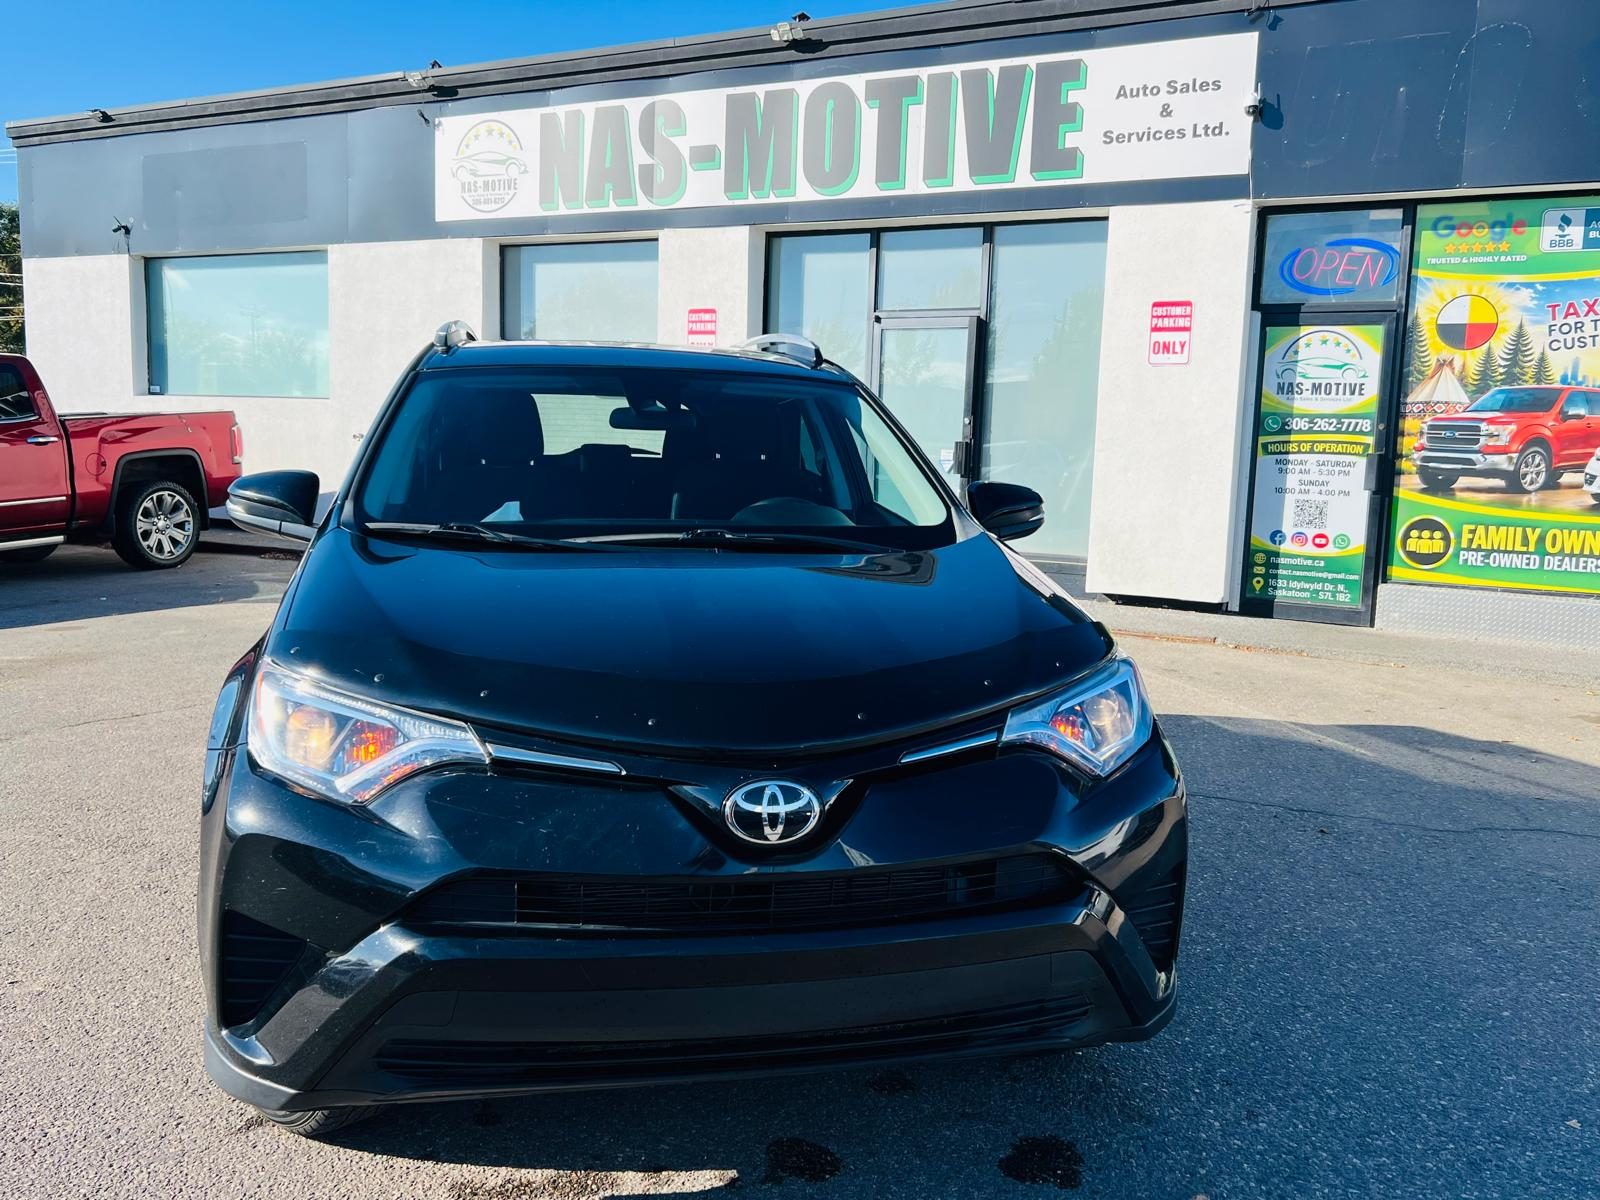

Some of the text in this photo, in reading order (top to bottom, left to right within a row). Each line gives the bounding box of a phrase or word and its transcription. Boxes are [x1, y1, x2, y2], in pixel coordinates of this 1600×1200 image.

[1115, 78, 1222, 100] Auto Sales
[1159, 103, 1173, 118] &
[539, 58, 1088, 211] NAS-MOTIVE
[1102, 121, 1230, 145] Services Ltd.
[461, 178, 518, 194] NAS-MOTIVE
[1431, 212, 1527, 242] Google
[1549, 239, 1574, 249] BBB
[1293, 247, 1385, 287] OPEN
[1427, 257, 1461, 265] TRUSTED
[1152, 306, 1191, 316] CUSTOMER
[1546, 298, 1600, 321] TAX
[1152, 317, 1191, 328] PARKING
[1548, 321, 1585, 337] FOR
[1152, 340, 1187, 355] ONLY
[1548, 334, 1600, 352] CUST
[1276, 382, 1365, 396] NAS-MOTIVE
[1284, 417, 1371, 432] 306-262-7778
[1268, 443, 1363, 454] HOURS OF OPERATION
[1274, 458, 1308, 466] MONDAY
[1316, 460, 1357, 468] SATURDAY
[1277, 467, 1296, 475] 9:00
[1274, 487, 1296, 495] 10:00
[1461, 524, 1542, 552] FAMILY
[1270, 556, 1325, 567] nasmotive.ca
[1459, 550, 1540, 570] PRE-OWNED
[1268, 578, 1287, 587] 1633
[1288, 580, 1322, 590] Idylwyld
[1267, 587, 1310, 598] Saskatoon
[1318, 591, 1334, 600] S7L
[1335, 592, 1351, 602] 1B2
